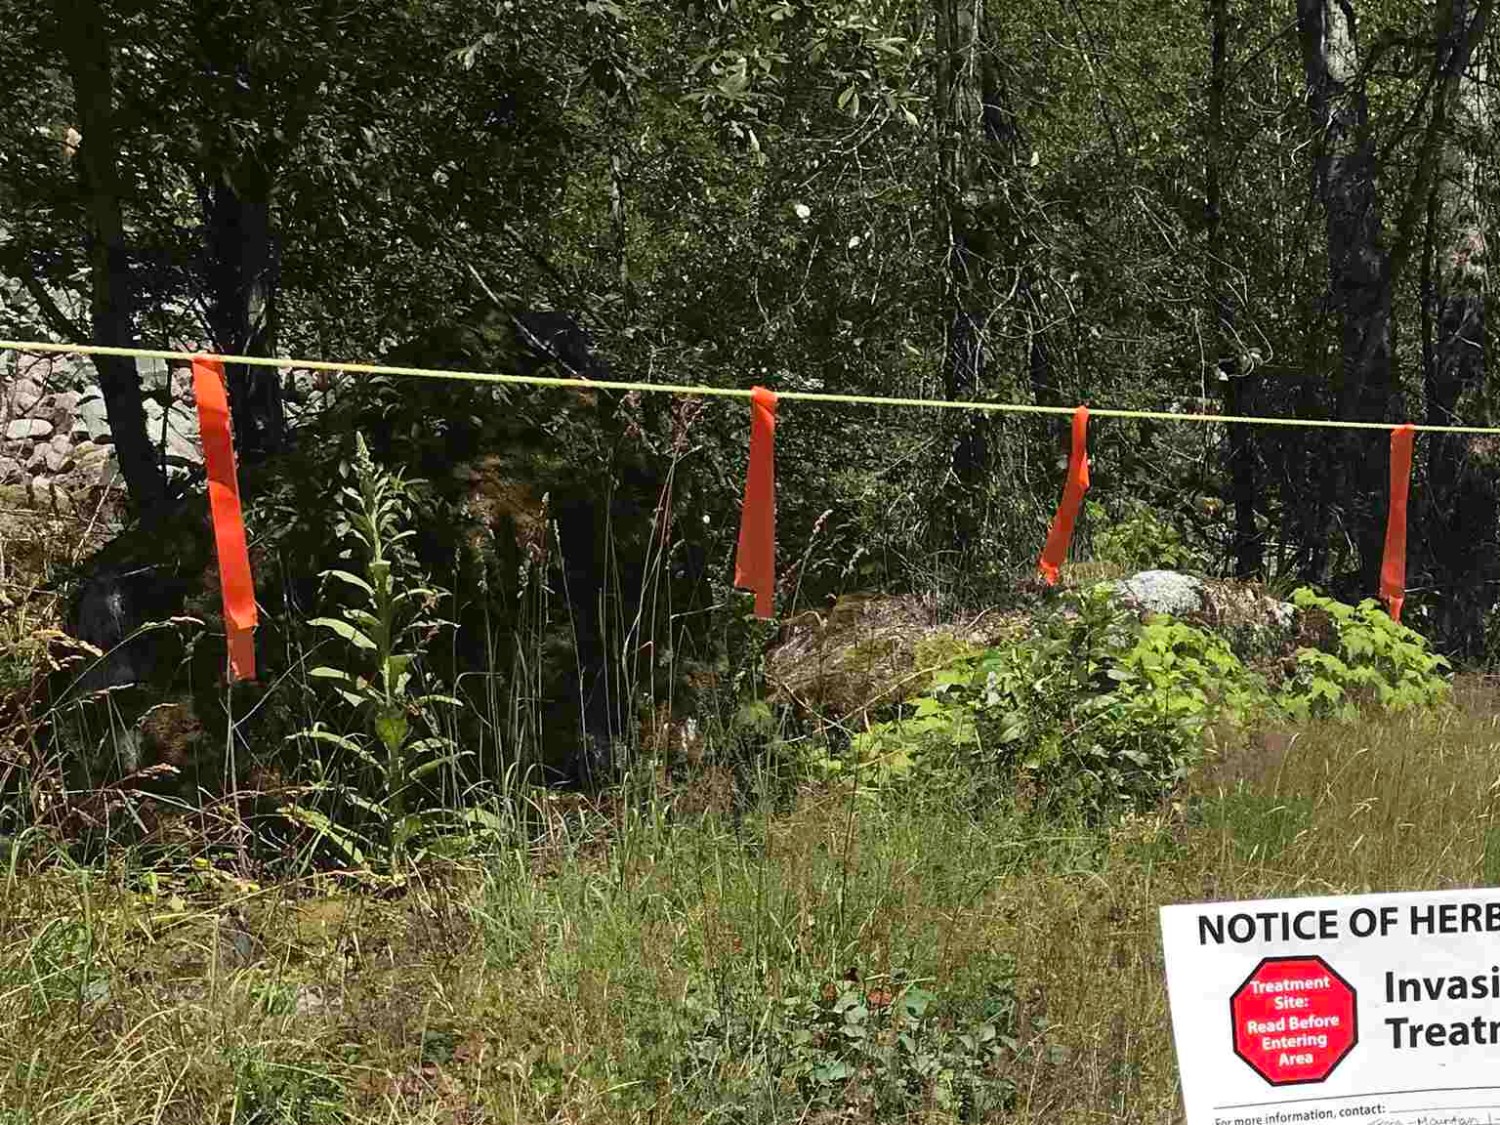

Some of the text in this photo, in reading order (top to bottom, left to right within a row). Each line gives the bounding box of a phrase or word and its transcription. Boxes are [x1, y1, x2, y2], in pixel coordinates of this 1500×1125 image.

[1198, 908, 1338, 945] NOTICE
[1349, 907, 1399, 937] OF
[1250, 975, 1331, 994] Treatment
[1274, 996, 1309, 1010] Site:
[1247, 1014, 1340, 1034] Read Before
[1261, 1034, 1328, 1050] Entering
[1279, 1052, 1314, 1066] Area
[1265, 1109, 1337, 1125] information,
[1339, 1104, 1386, 1118] contact:
